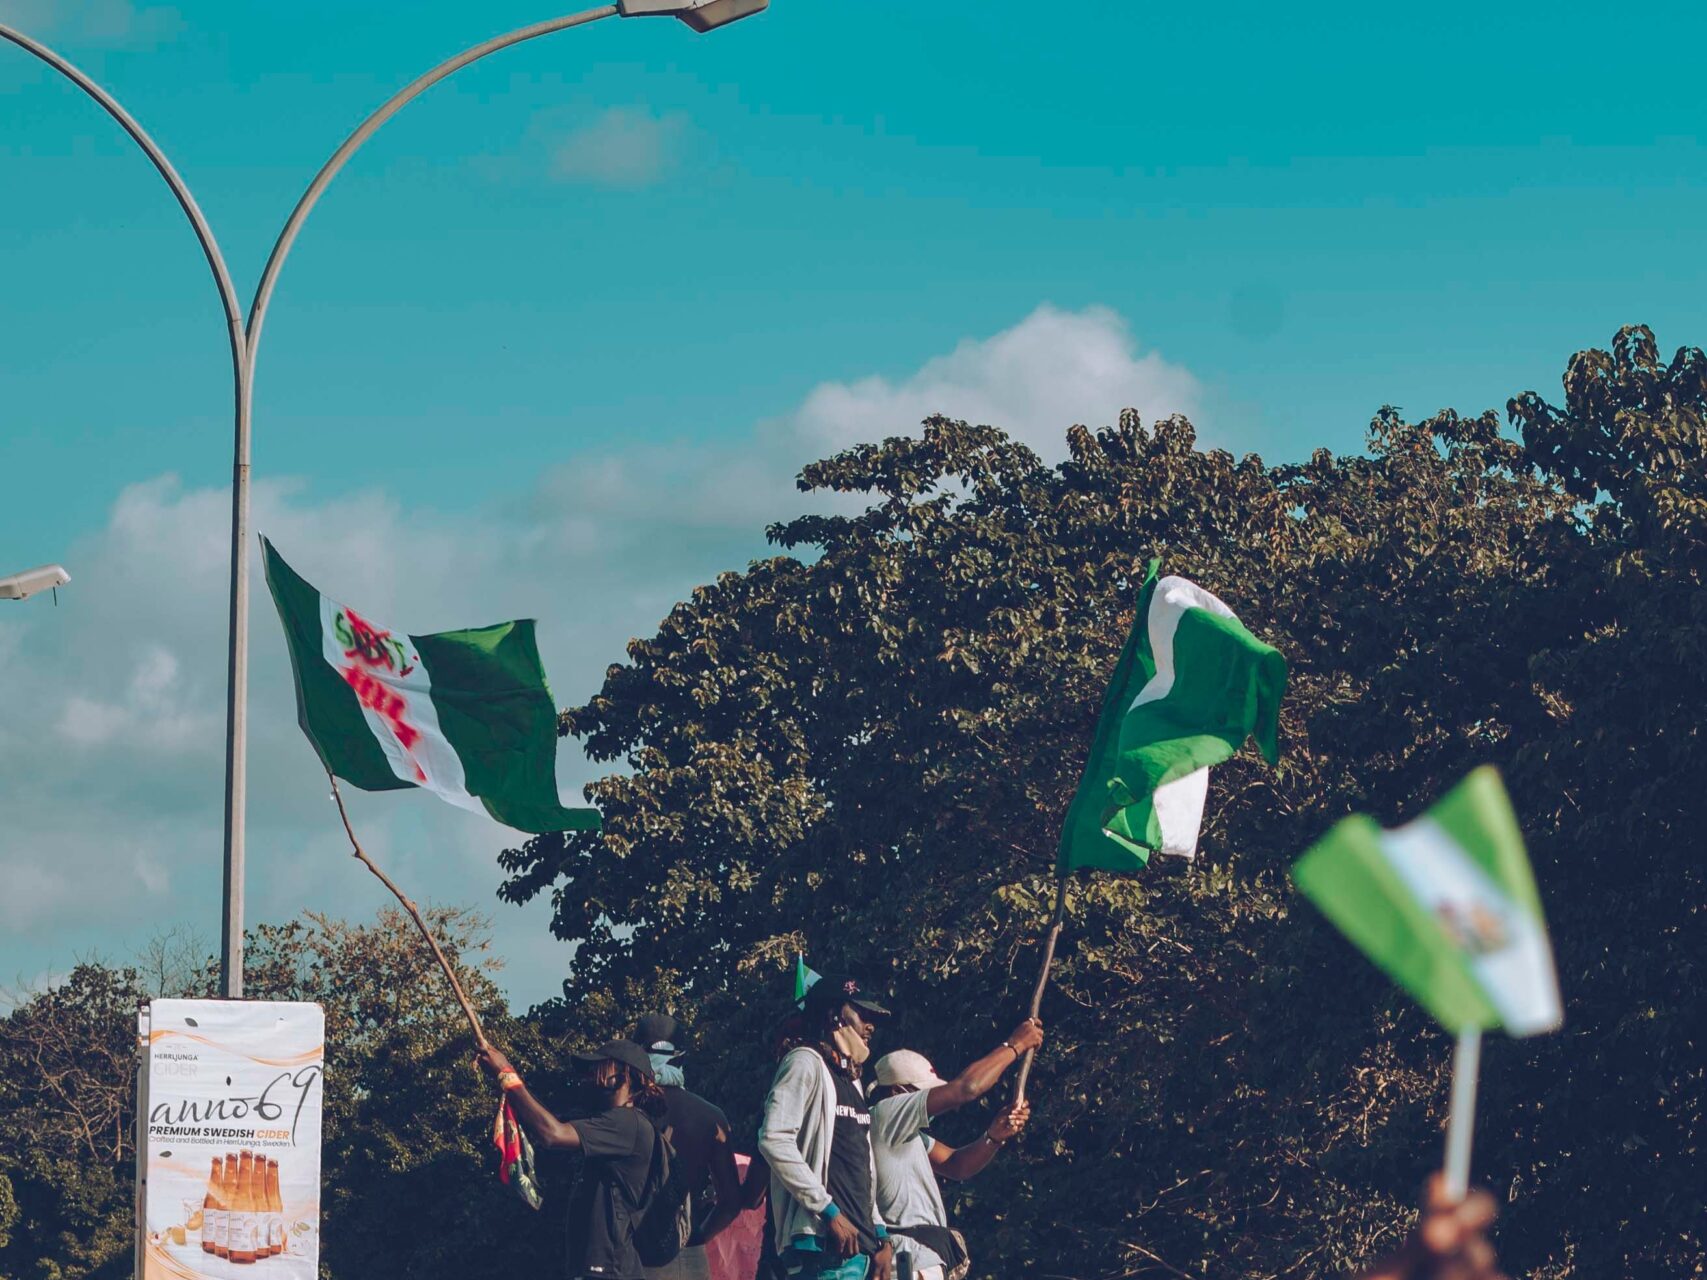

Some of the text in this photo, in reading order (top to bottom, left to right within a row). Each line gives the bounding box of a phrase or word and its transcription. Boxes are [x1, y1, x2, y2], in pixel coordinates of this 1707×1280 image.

[149, 1125, 290, 1140] PREMIUM SWEDISH CIDER
